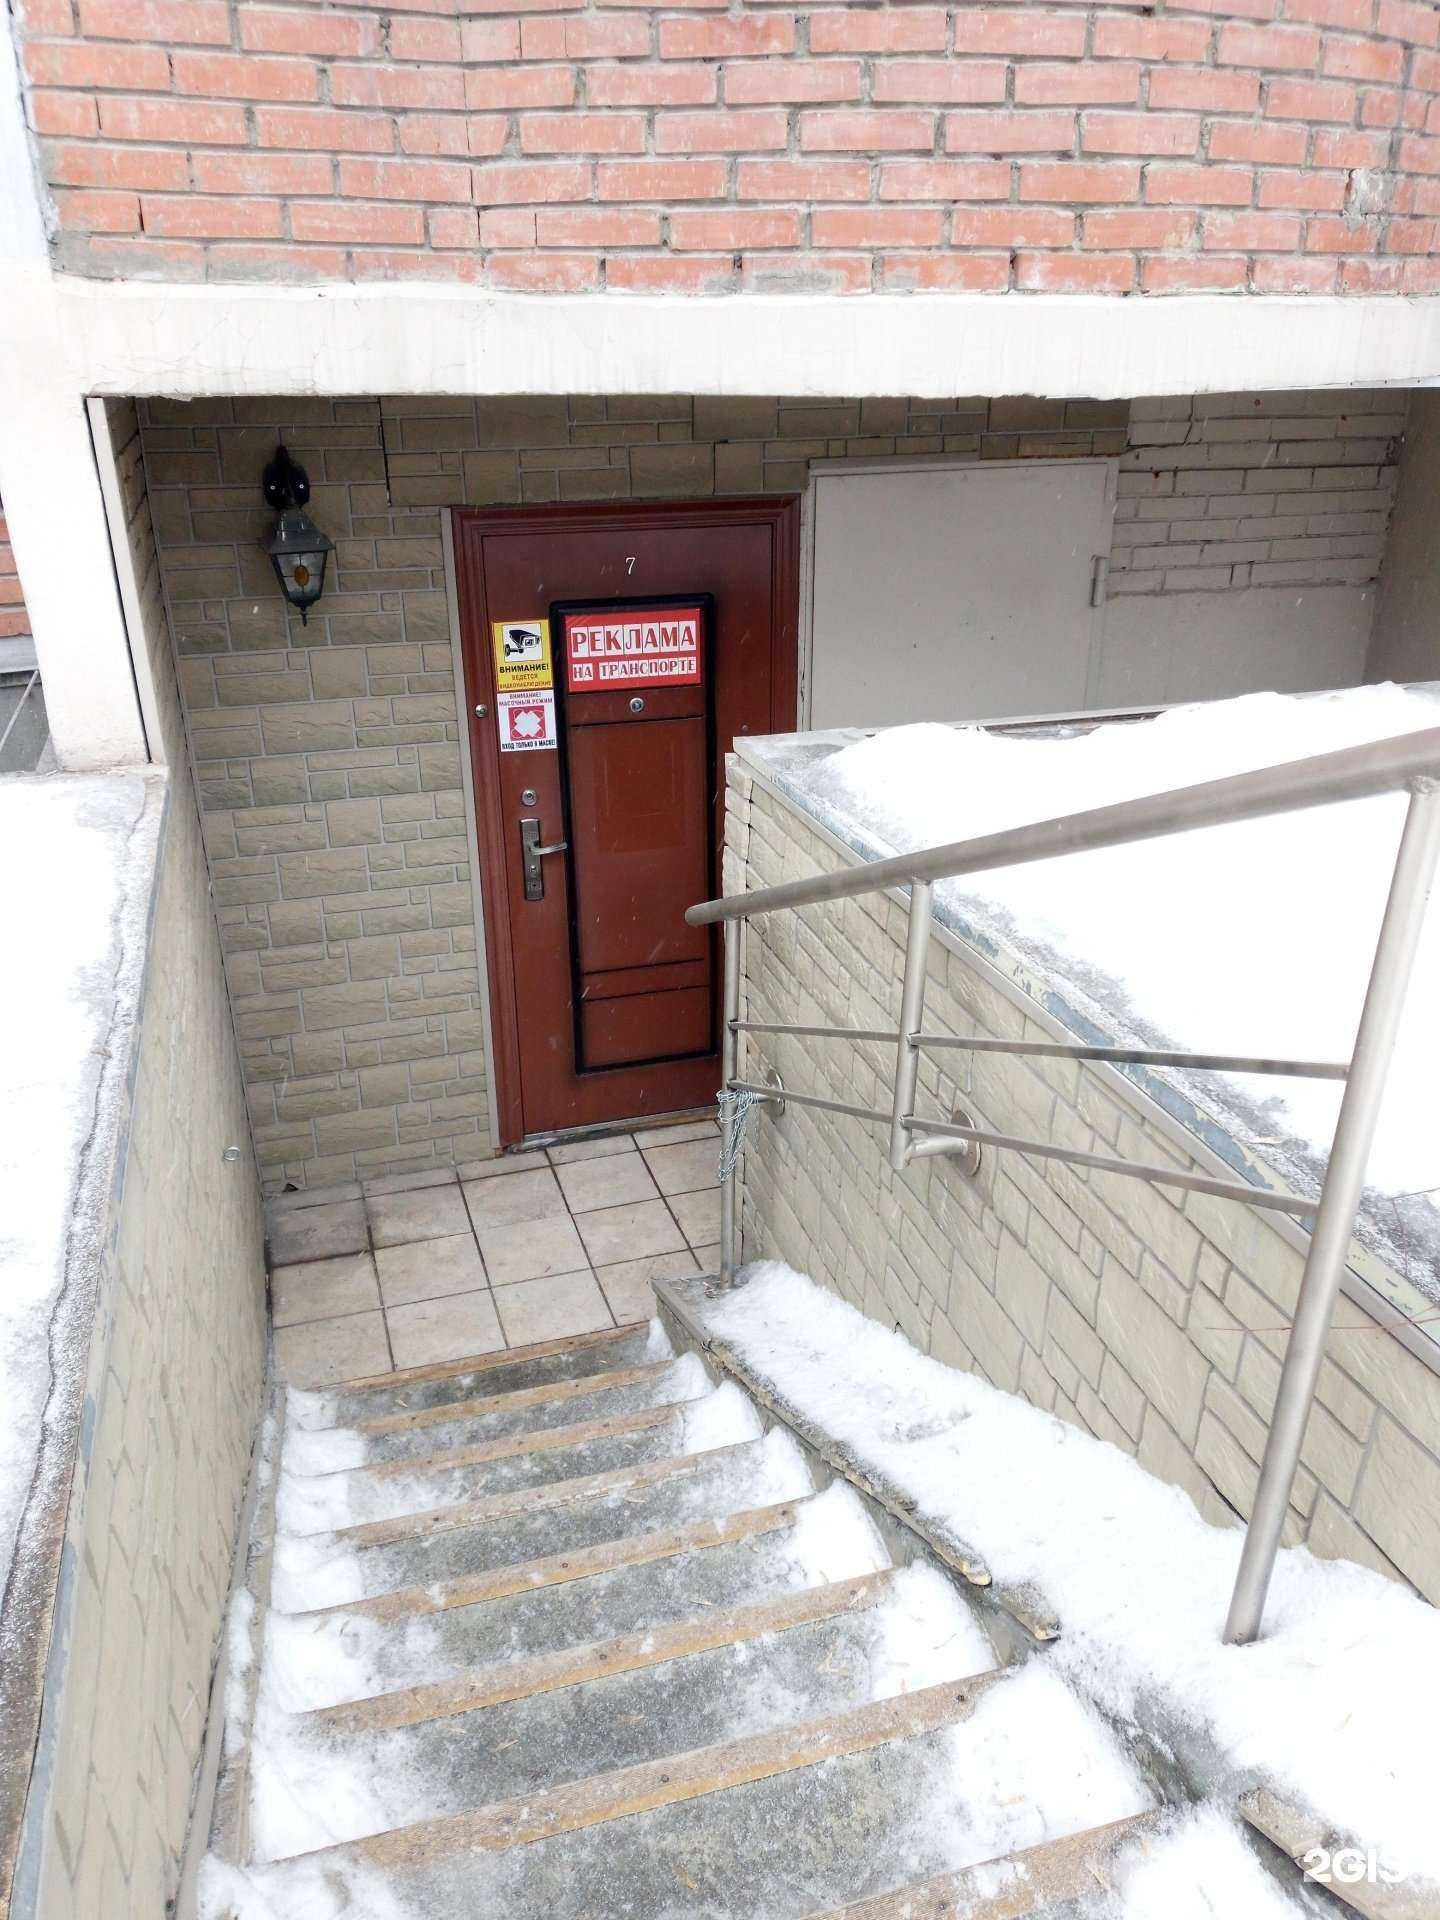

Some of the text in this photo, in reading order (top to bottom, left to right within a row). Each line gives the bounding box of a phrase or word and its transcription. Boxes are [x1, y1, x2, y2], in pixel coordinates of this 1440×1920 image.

[625, 557, 636, 575] 7
[572, 626, 695, 653] РЕКЛАМА
[499, 664, 549, 673] ВНИМАНИЕ!
[573, 659, 696, 679] НА ТРАНСПОРТЕ
